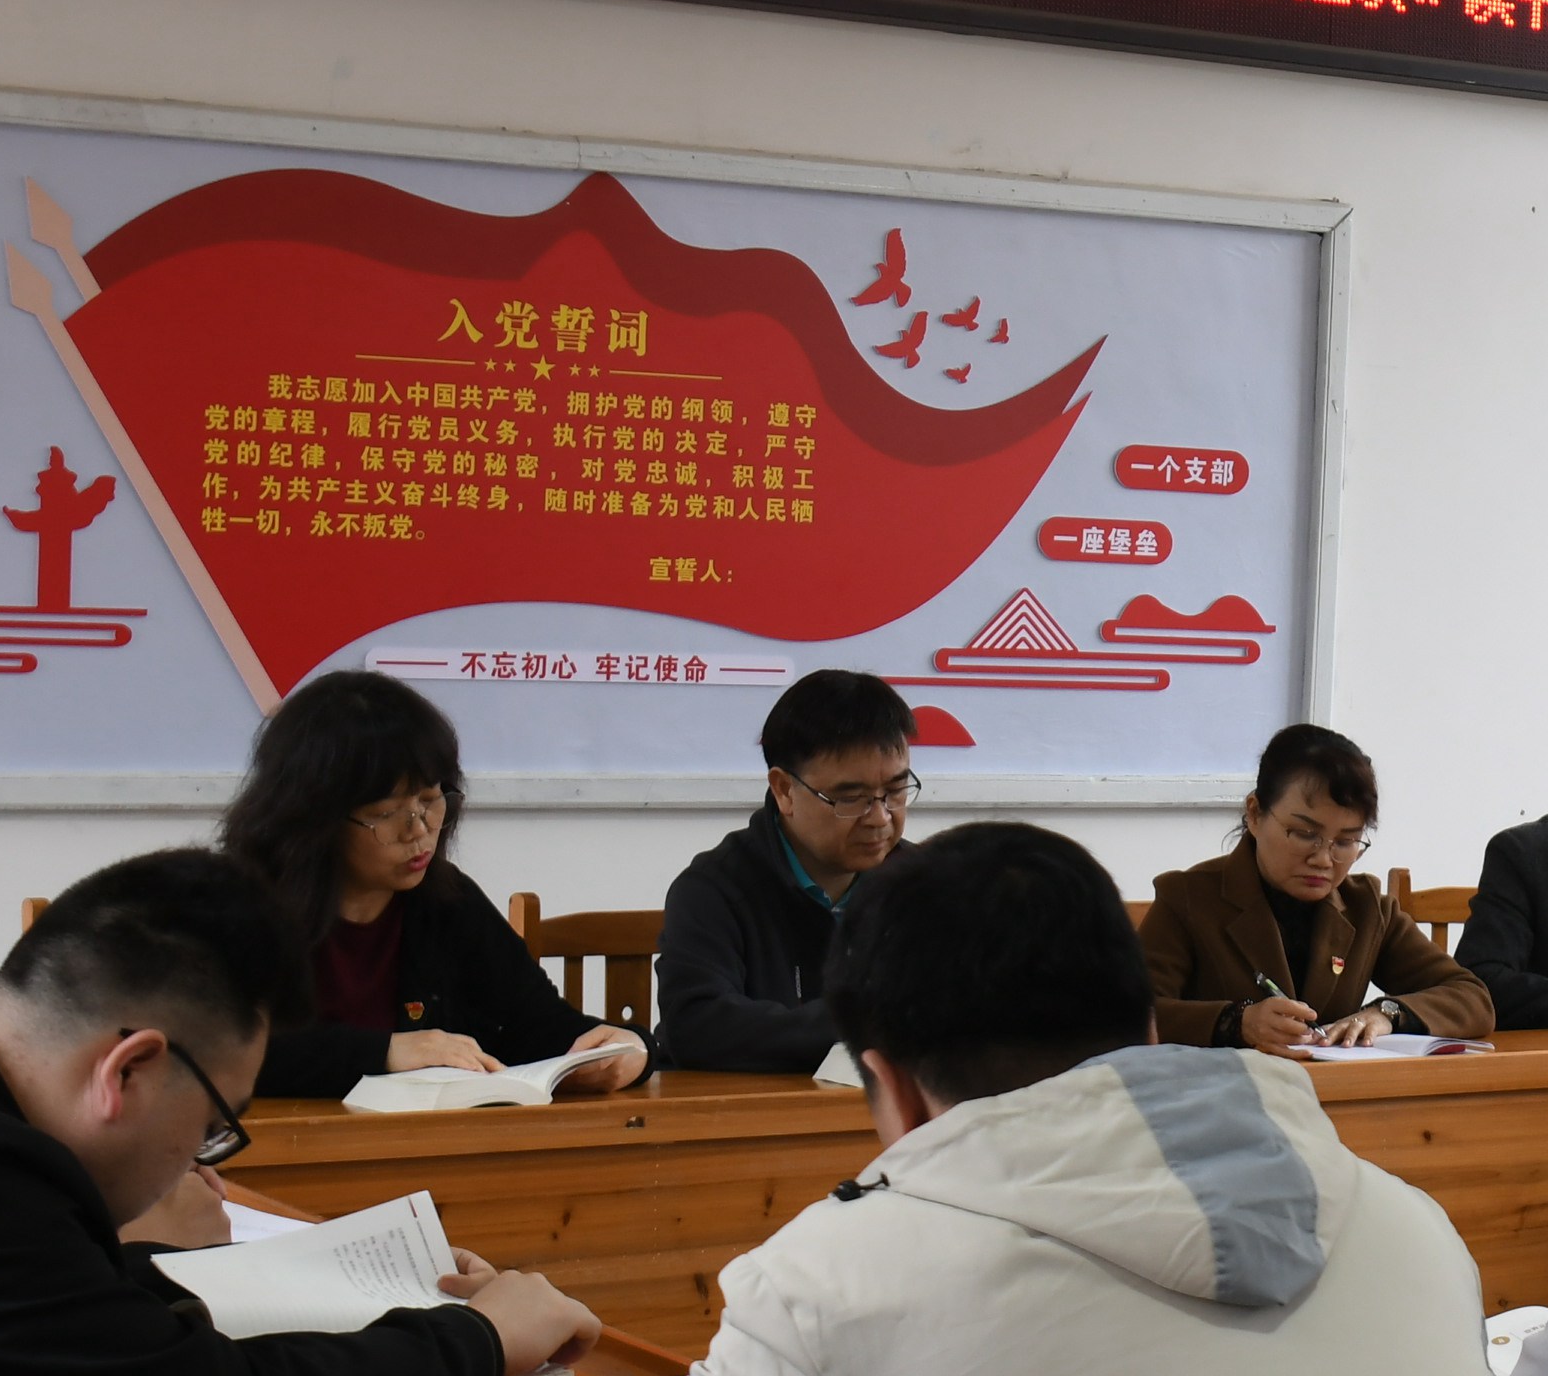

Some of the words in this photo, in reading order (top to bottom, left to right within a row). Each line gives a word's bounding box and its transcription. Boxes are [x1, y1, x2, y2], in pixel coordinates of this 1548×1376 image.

[437, 298, 649, 357] 入党誓词
[268, 373, 818, 429] 我志愿加入中国共产党，拥护党的纲领，遵守
[204, 404, 817, 460] 党的章程，履行党员义务，执行党的决定，严守
[203, 438, 815, 491] 党的纪律，保守党的秘密，对党忠诚，积极工
[1130, 454, 1235, 487] 一个支部
[201, 506, 426, 541] 牲一切，永不叛党。
[202, 472, 814, 524] 作，为共产主义奋斗终身，随时准备为党和人民牺
[1053, 526, 1159, 557] 一座堡垒
[460, 651, 578, 680] 不忘初心
[595, 653, 709, 683] 牢记使命
